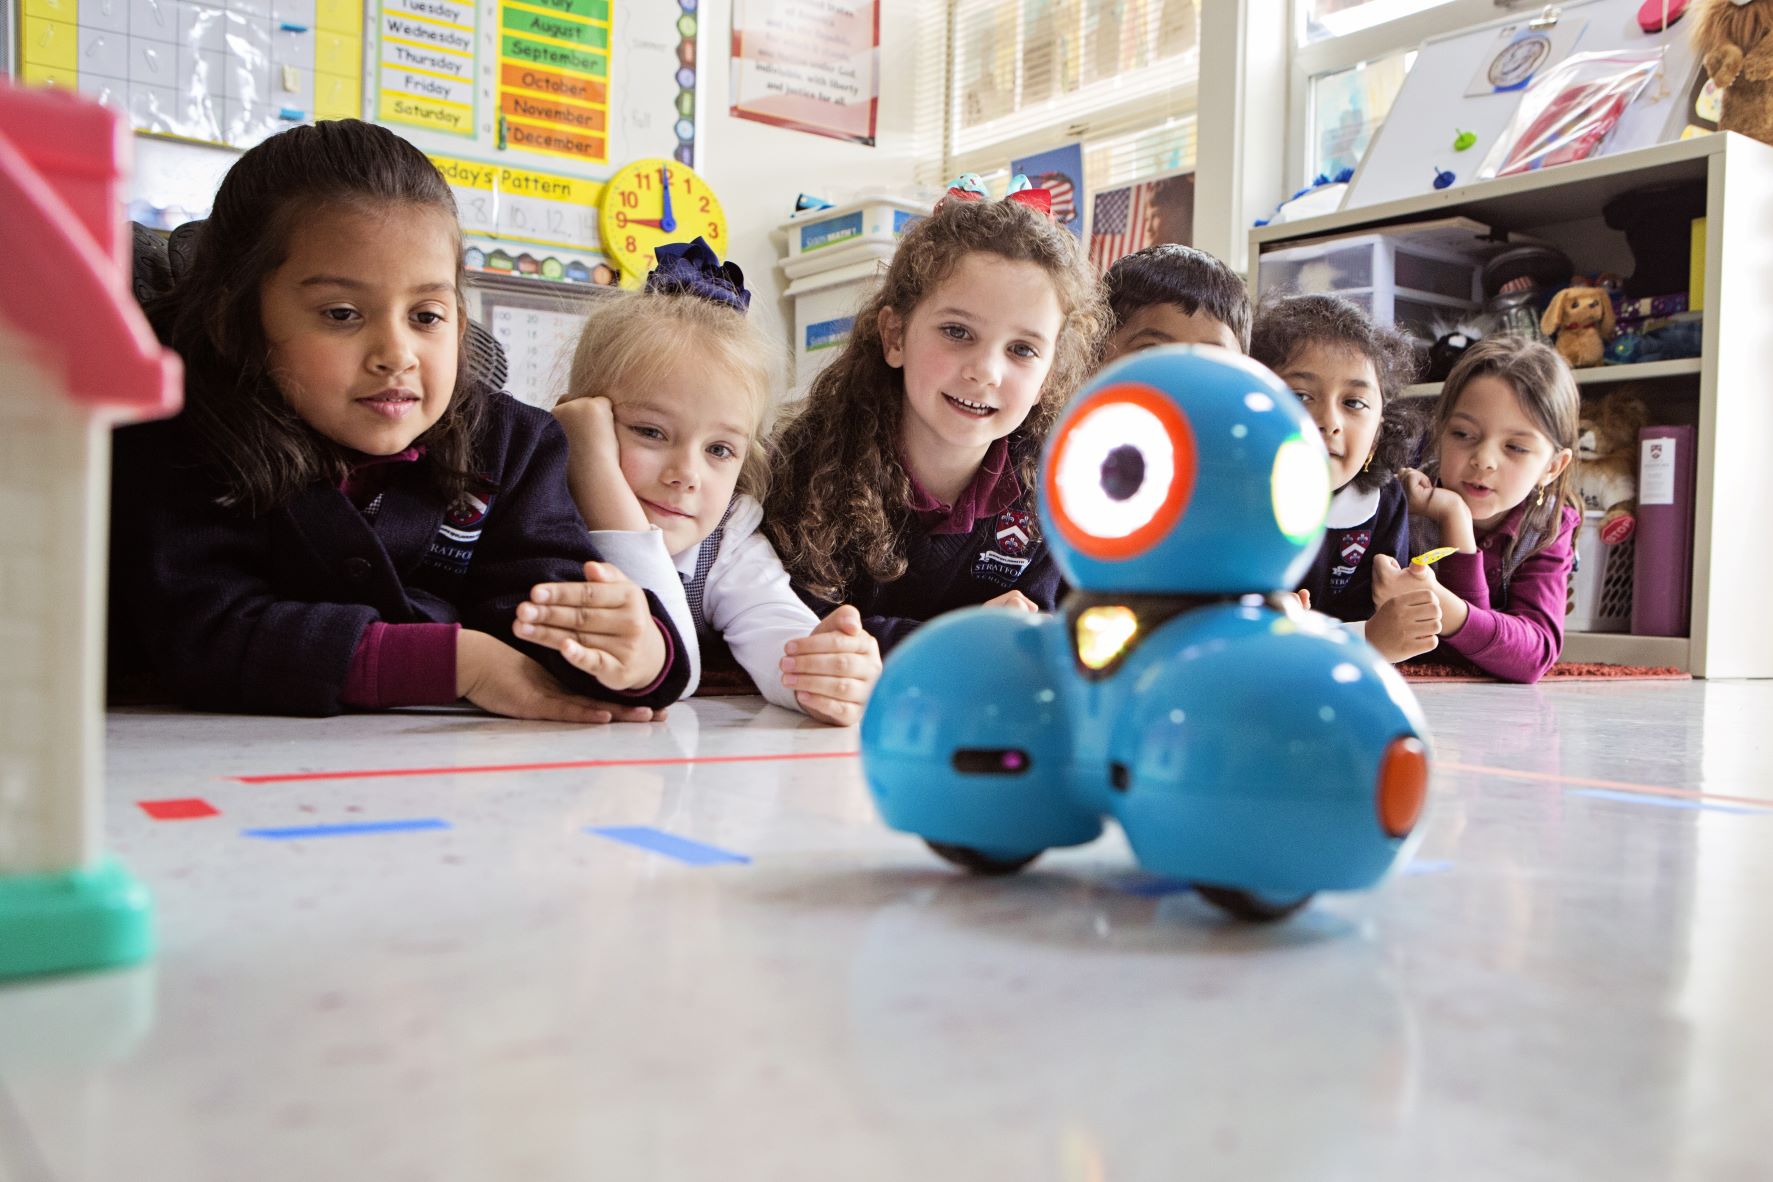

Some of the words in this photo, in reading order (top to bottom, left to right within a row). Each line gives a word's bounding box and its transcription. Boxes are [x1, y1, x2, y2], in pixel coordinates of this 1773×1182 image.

[387, 18, 470, 51] Wednesday
[531, 17, 582, 38] August
[396, 46, 462, 75] Thursday
[512, 41, 599, 68] September
[405, 75, 450, 100] Friday
[522, 72, 587, 96] October
[394, 101, 460, 127] Saturday
[514, 98, 593, 126] November
[514, 126, 592, 154] December
[501, 169, 571, 196] Pattern
[635, 173, 650, 190] 11
[684, 178, 691, 194] 1
[619, 191, 638, 208] 10
[699, 196, 710, 213] 2
[615, 211, 627, 229] 9
[708, 222, 718, 239] 3
[625, 235, 636, 253] 8
